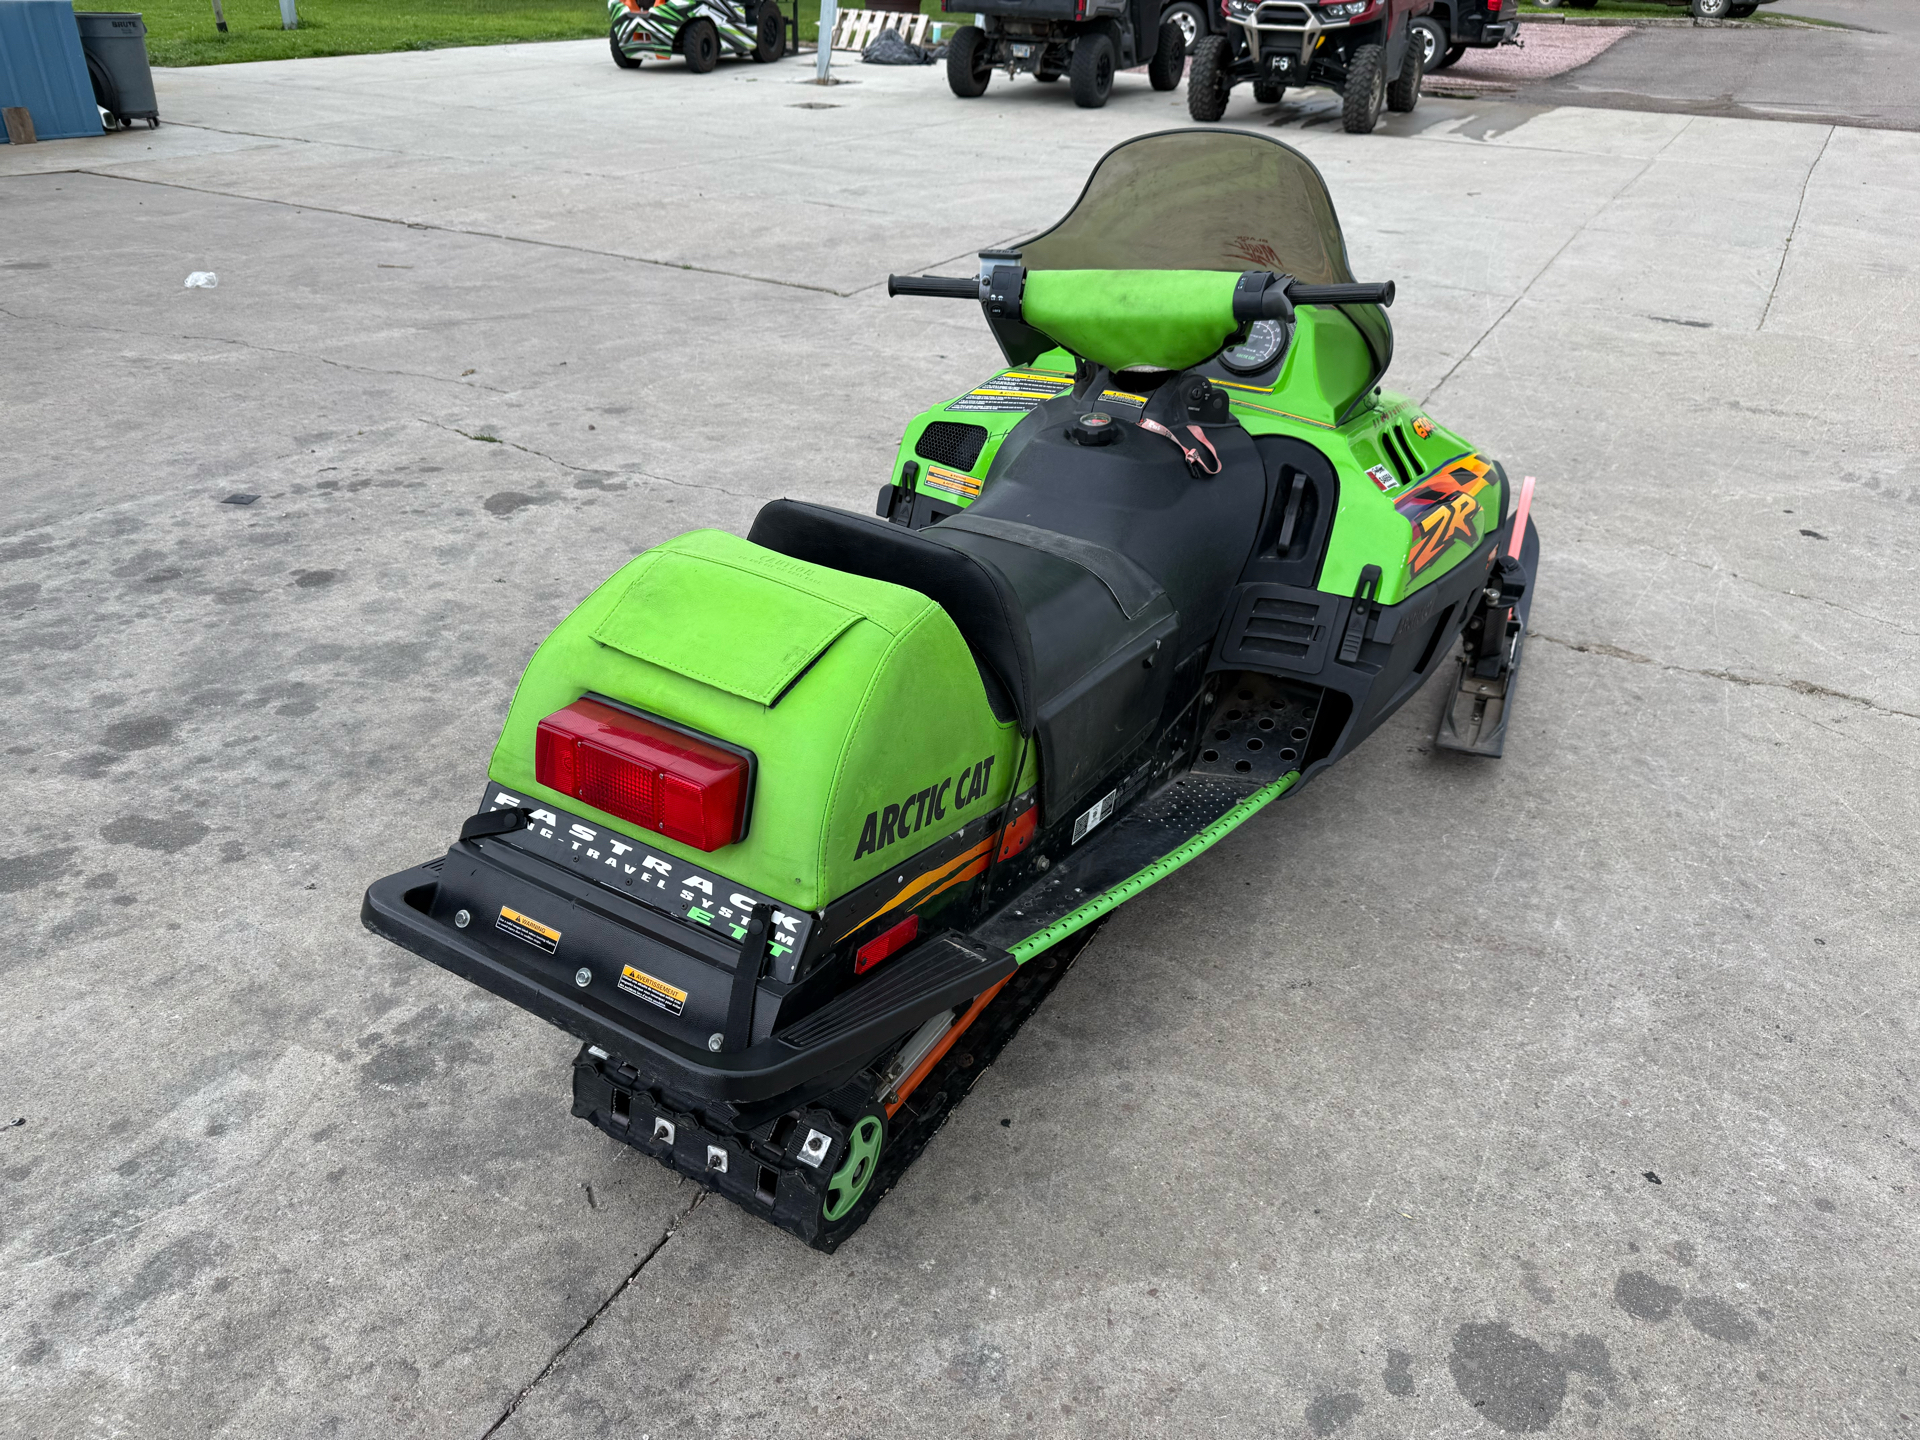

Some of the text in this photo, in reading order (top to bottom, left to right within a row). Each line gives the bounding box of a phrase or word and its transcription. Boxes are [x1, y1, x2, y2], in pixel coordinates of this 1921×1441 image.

[1409, 493, 1478, 573] ZR
[759, 555, 816, 576] CAUTION
[853, 754, 996, 861] ARCTIC CAT
[522, 918, 546, 934] WARNING
[680, 889, 795, 946] SYSTM
[636, 974, 679, 997] AVERTISSEMENT
